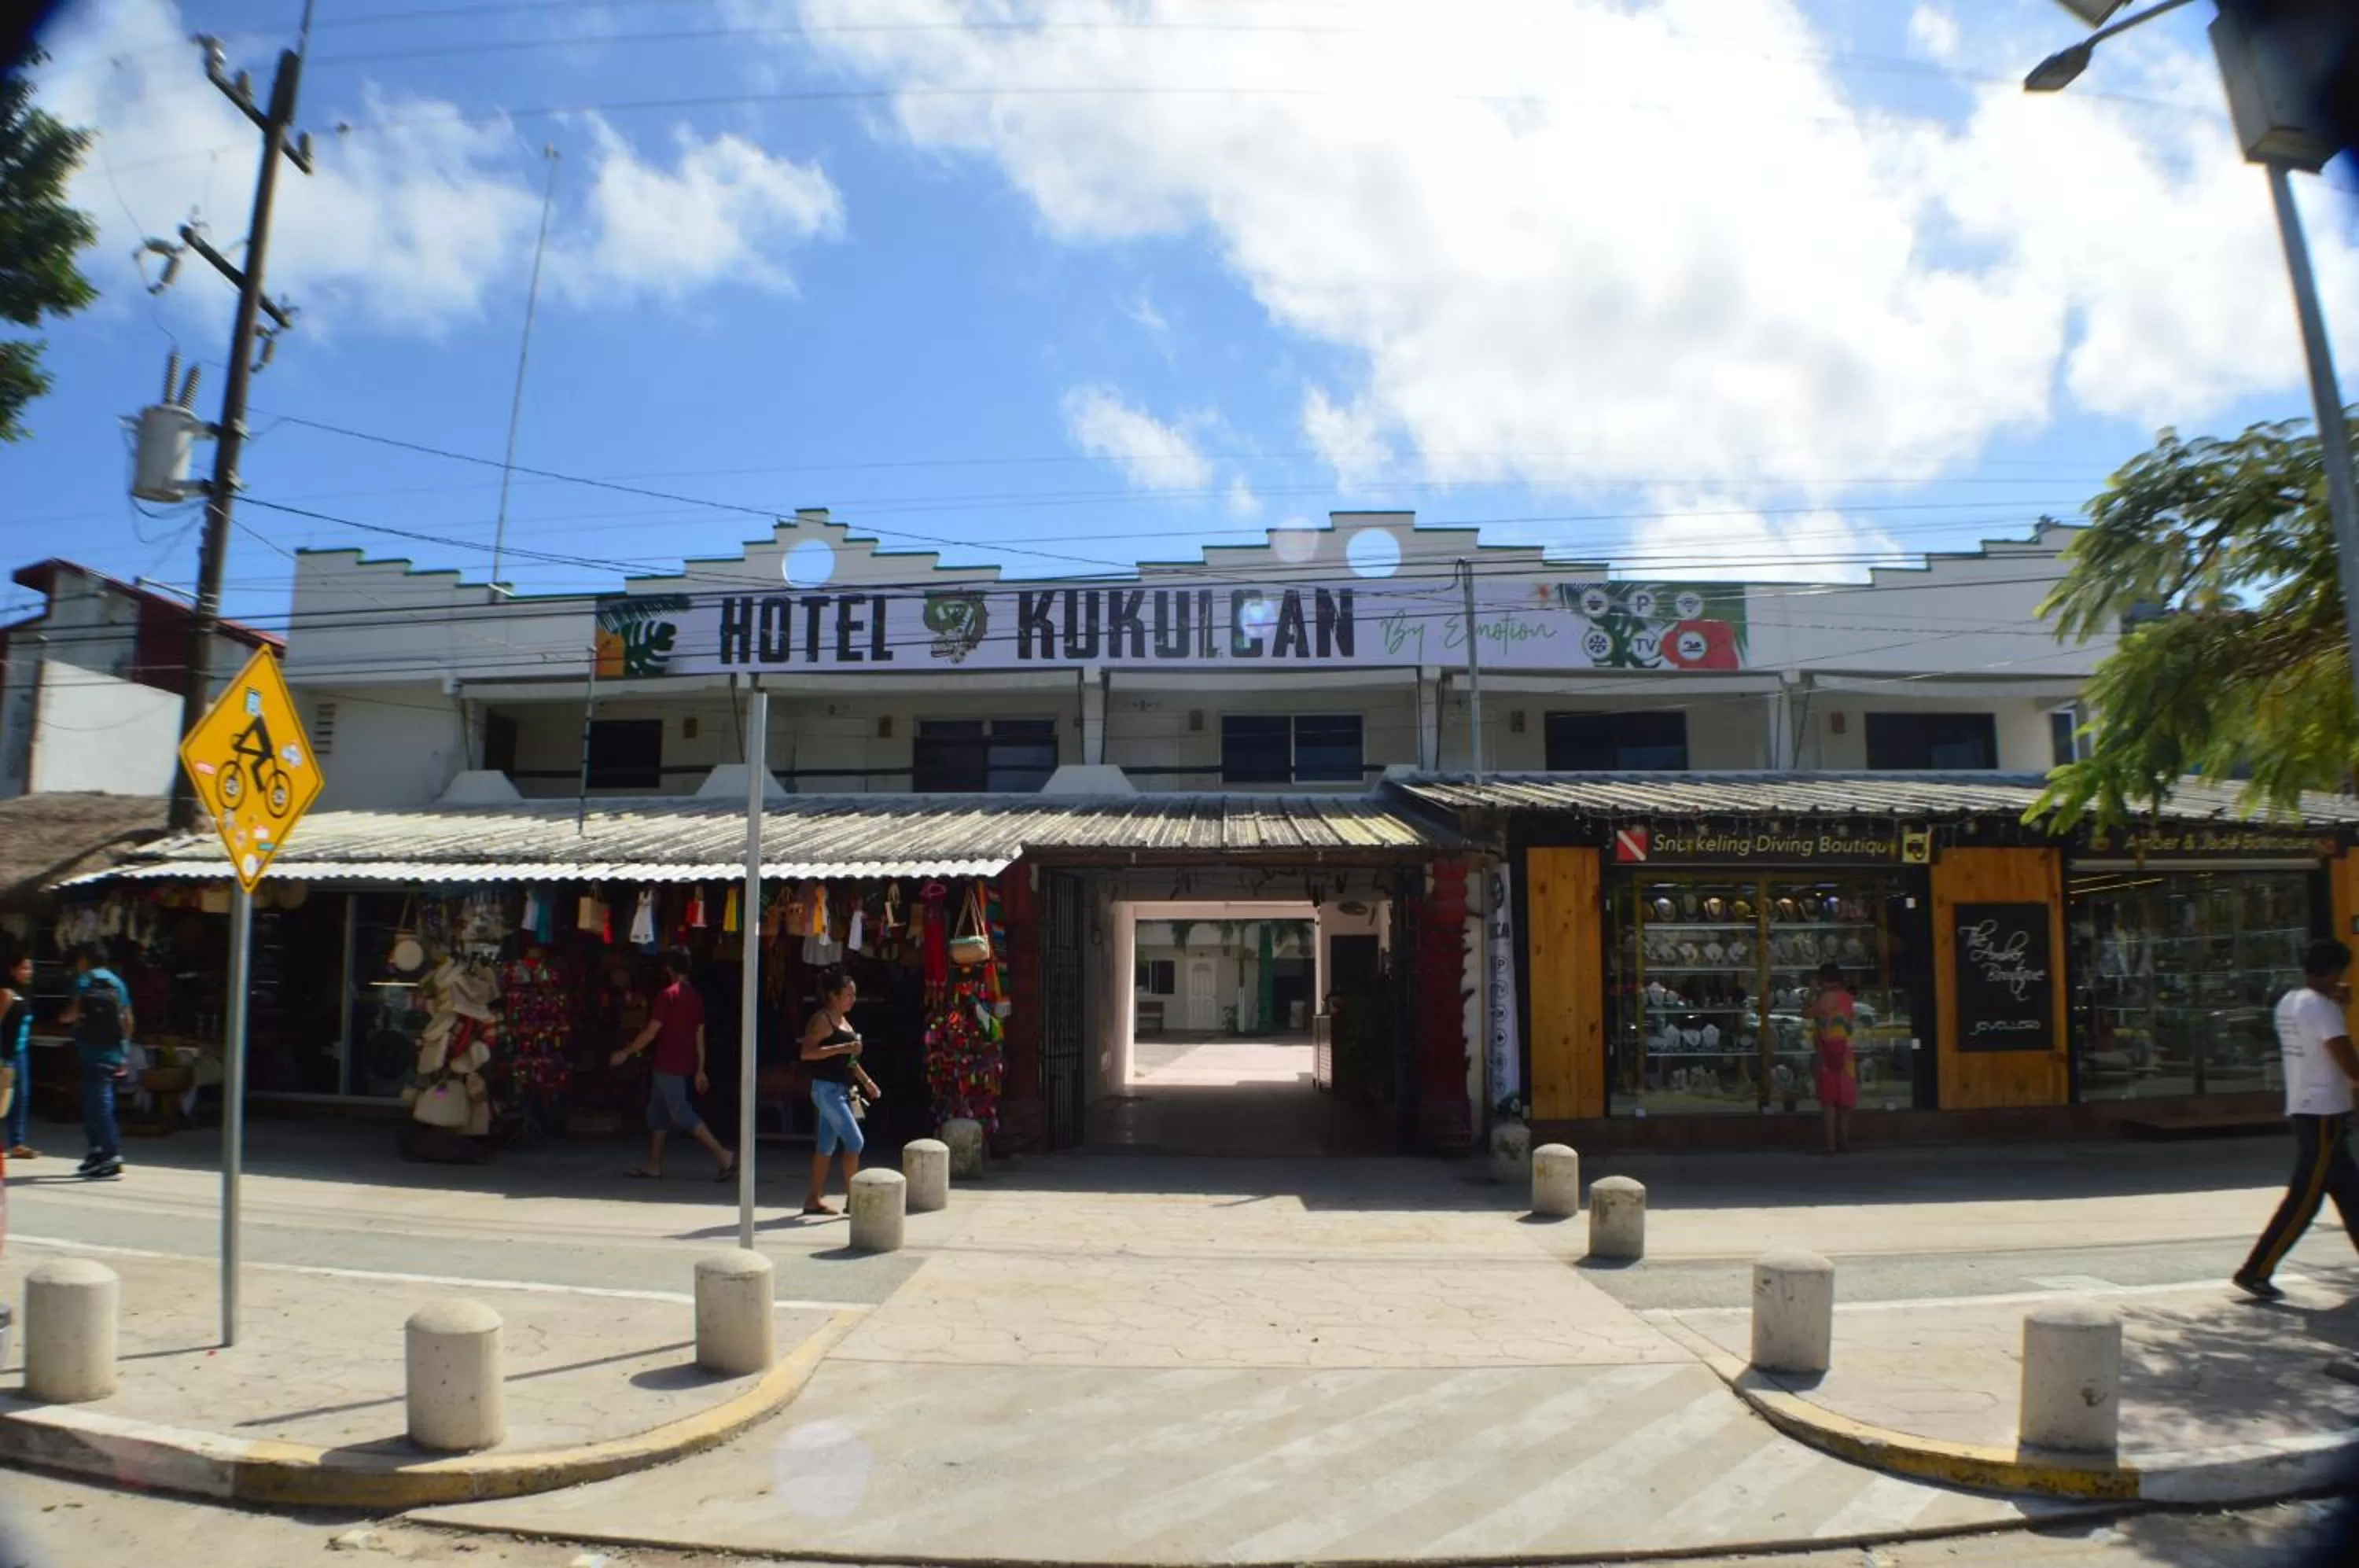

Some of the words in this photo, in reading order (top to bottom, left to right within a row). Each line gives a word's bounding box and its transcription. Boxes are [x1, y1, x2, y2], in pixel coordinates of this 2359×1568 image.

[720, 595, 893, 664] HOTEL
[1017, 587, 1356, 660] KUKULCAN
[1378, 608, 1425, 665] By
[1635, 638, 1657, 652] TV
[1654, 832, 1750, 856] Snokeling
[1756, 834, 1813, 856] Diving
[1819, 834, 1897, 855] Boutiqu
